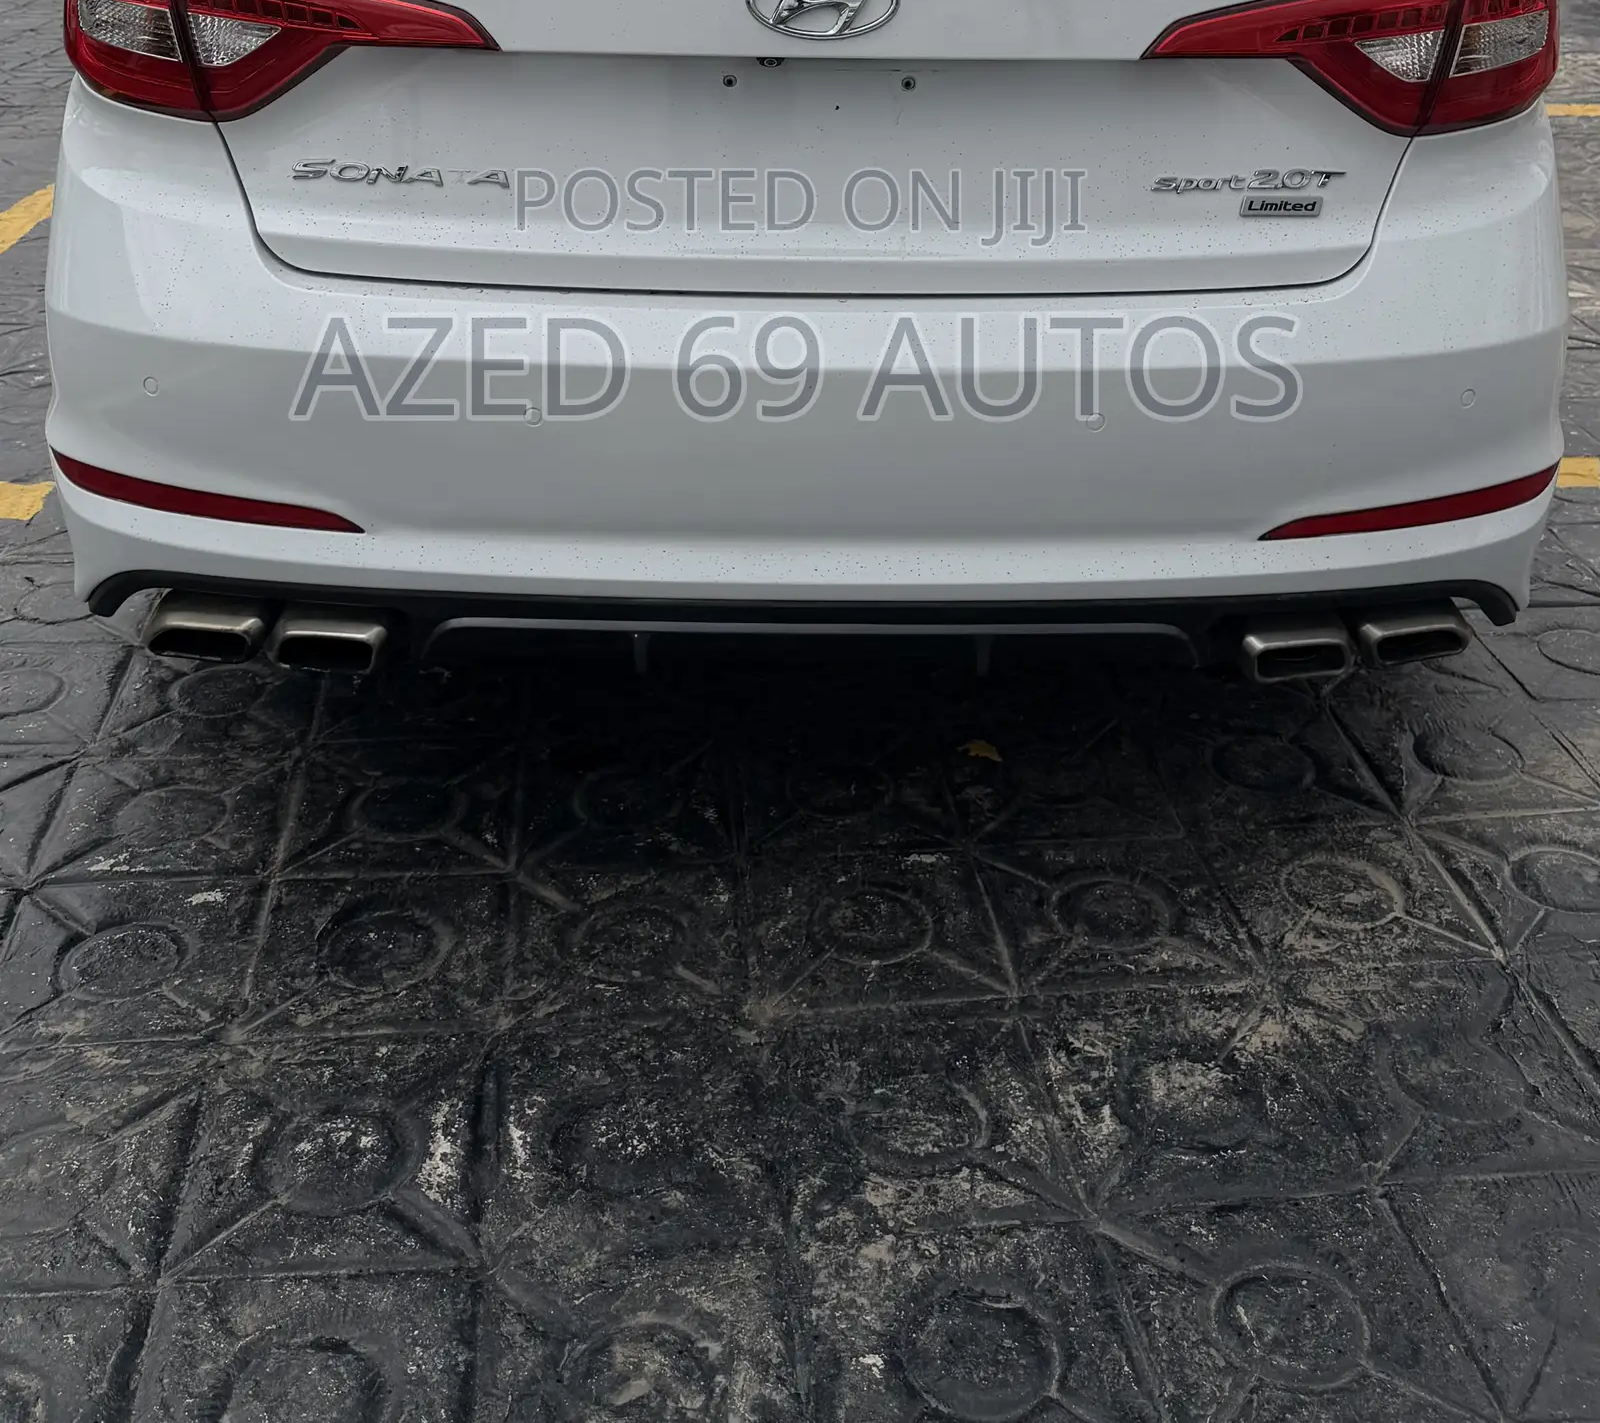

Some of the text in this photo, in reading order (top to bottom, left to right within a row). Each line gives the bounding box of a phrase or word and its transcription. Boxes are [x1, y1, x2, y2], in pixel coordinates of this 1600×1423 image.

[292, 158, 510, 189] SONATA
[1247, 169, 1347, 191] 2.0T
[1247, 200, 1317, 212] Limited
